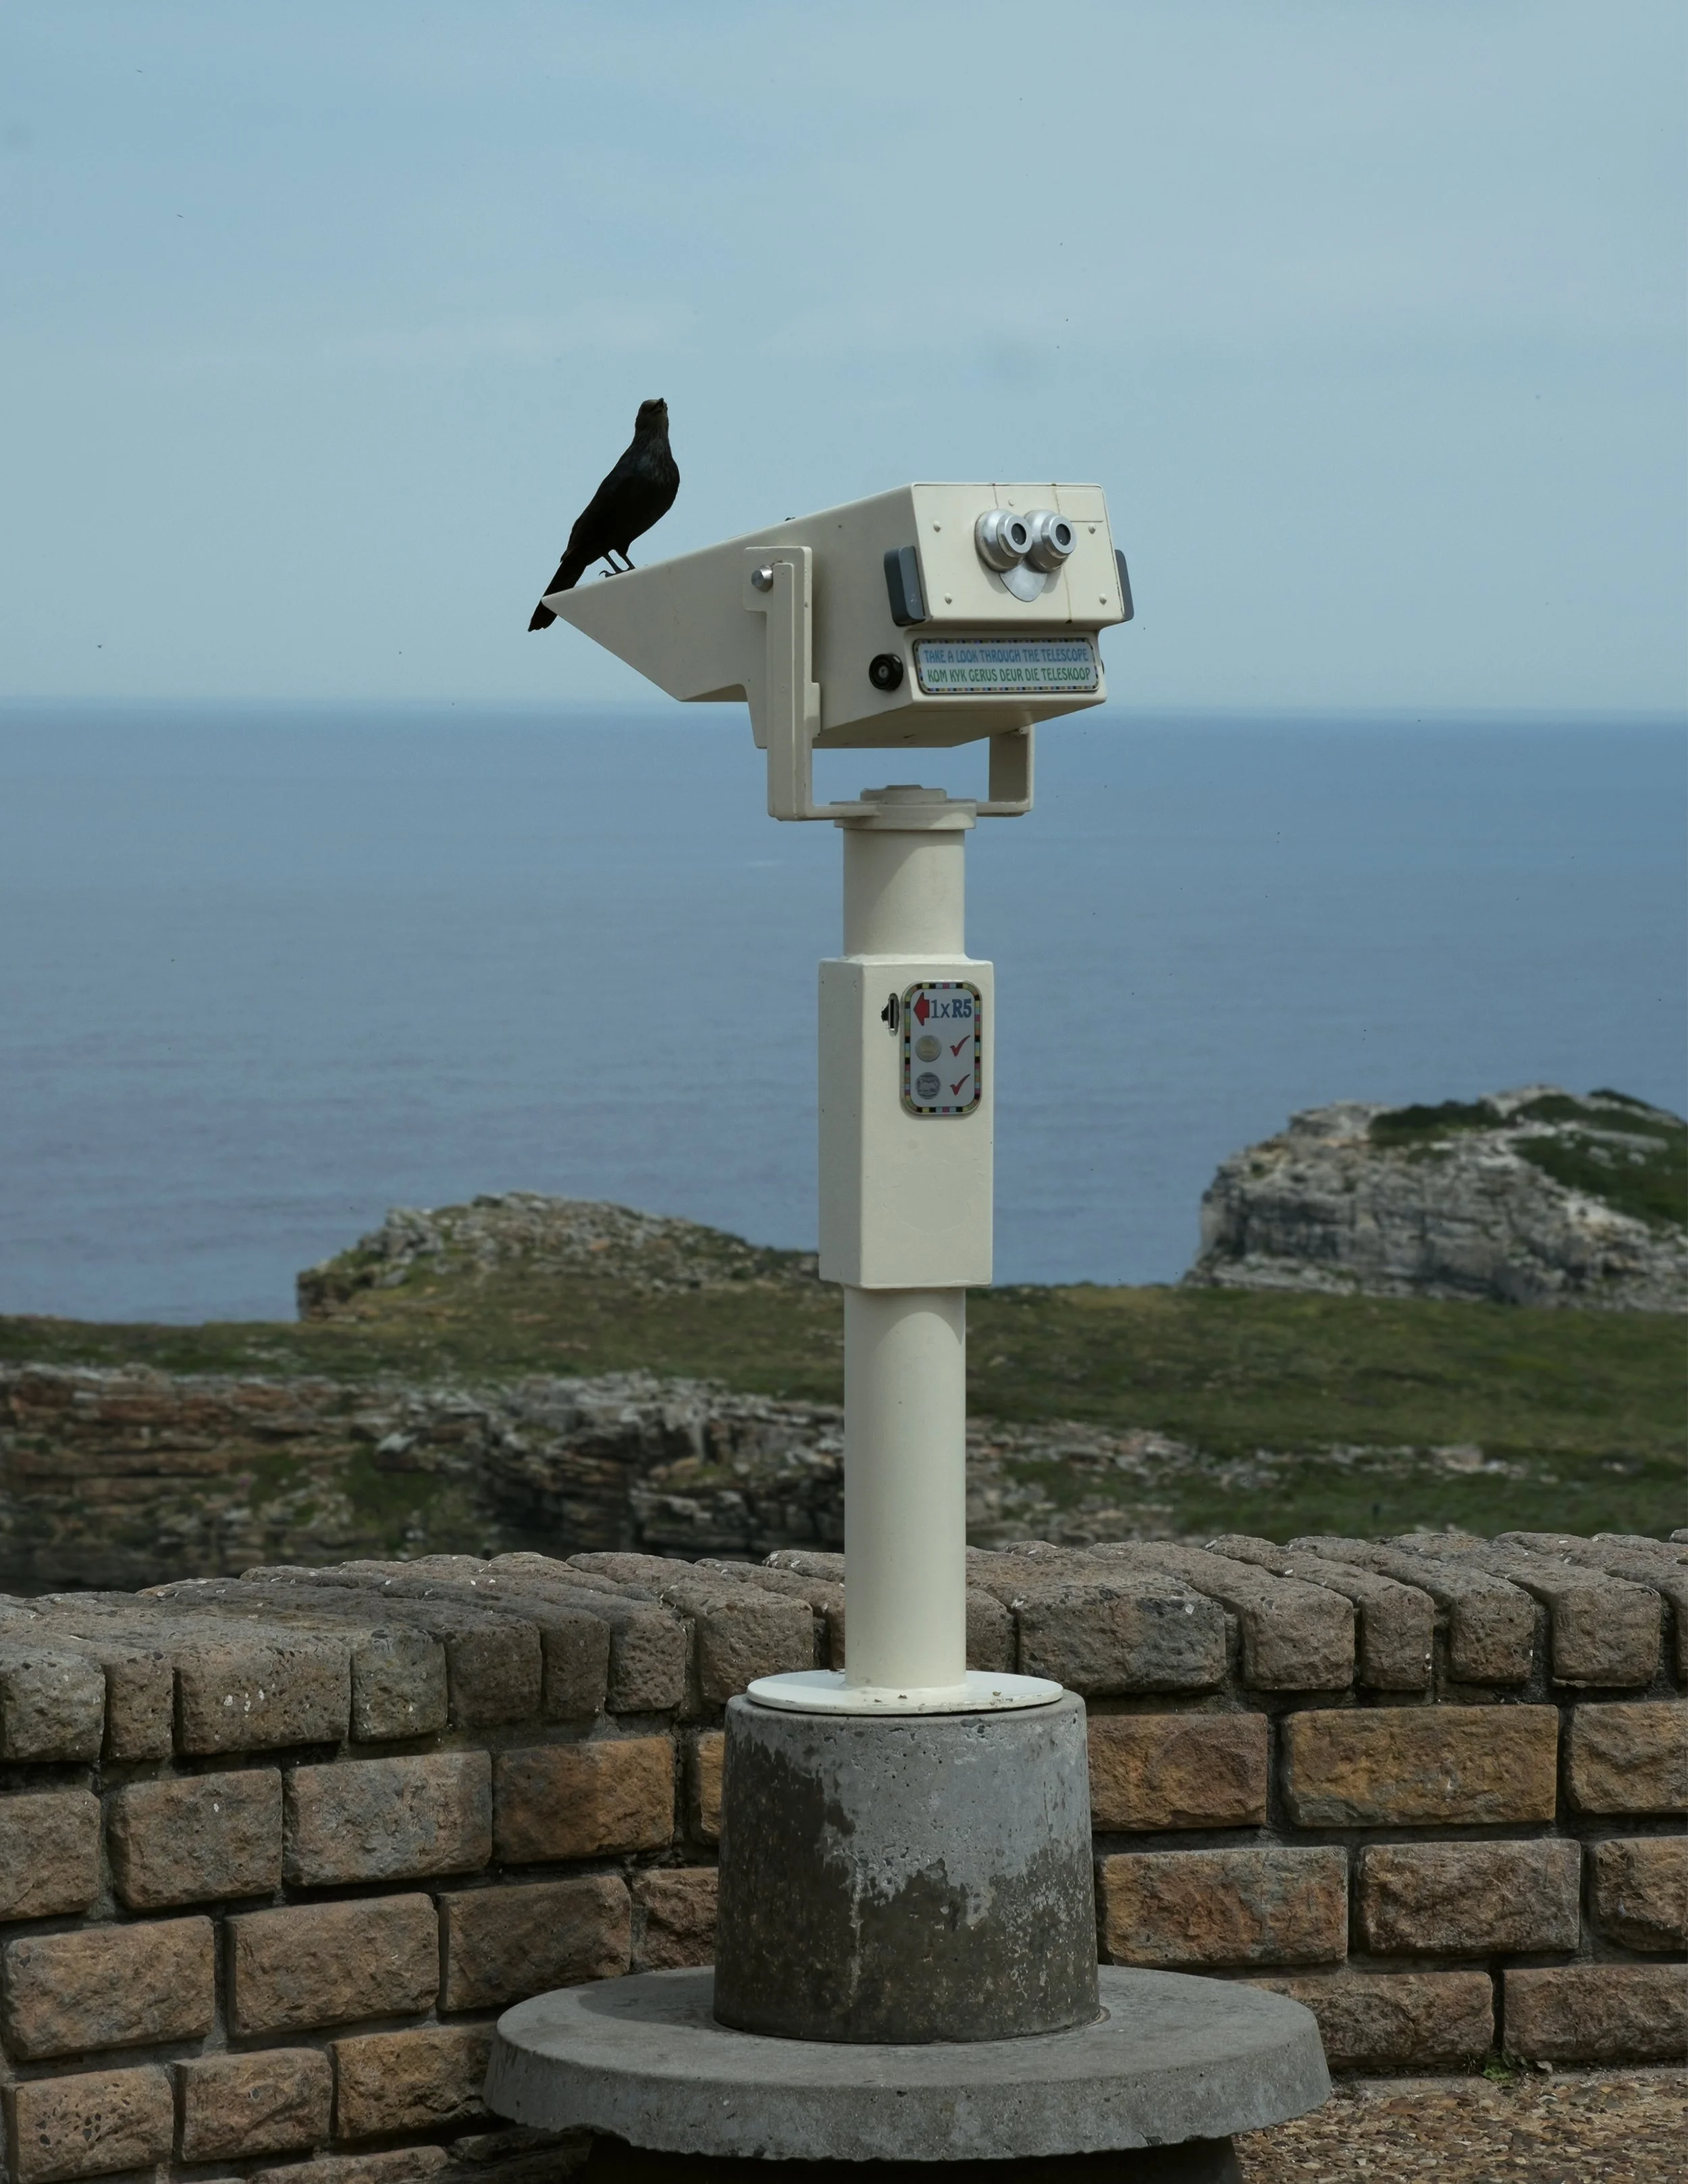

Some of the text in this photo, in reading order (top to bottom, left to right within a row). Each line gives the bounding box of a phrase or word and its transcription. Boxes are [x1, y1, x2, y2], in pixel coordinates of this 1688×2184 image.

[924, 648, 1088, 664] TAKE A LOOK THROUGH THE TELESCOPE
[928, 667, 1090, 683] KOM KYK GERUS DEUR DIE TELESKOOP
